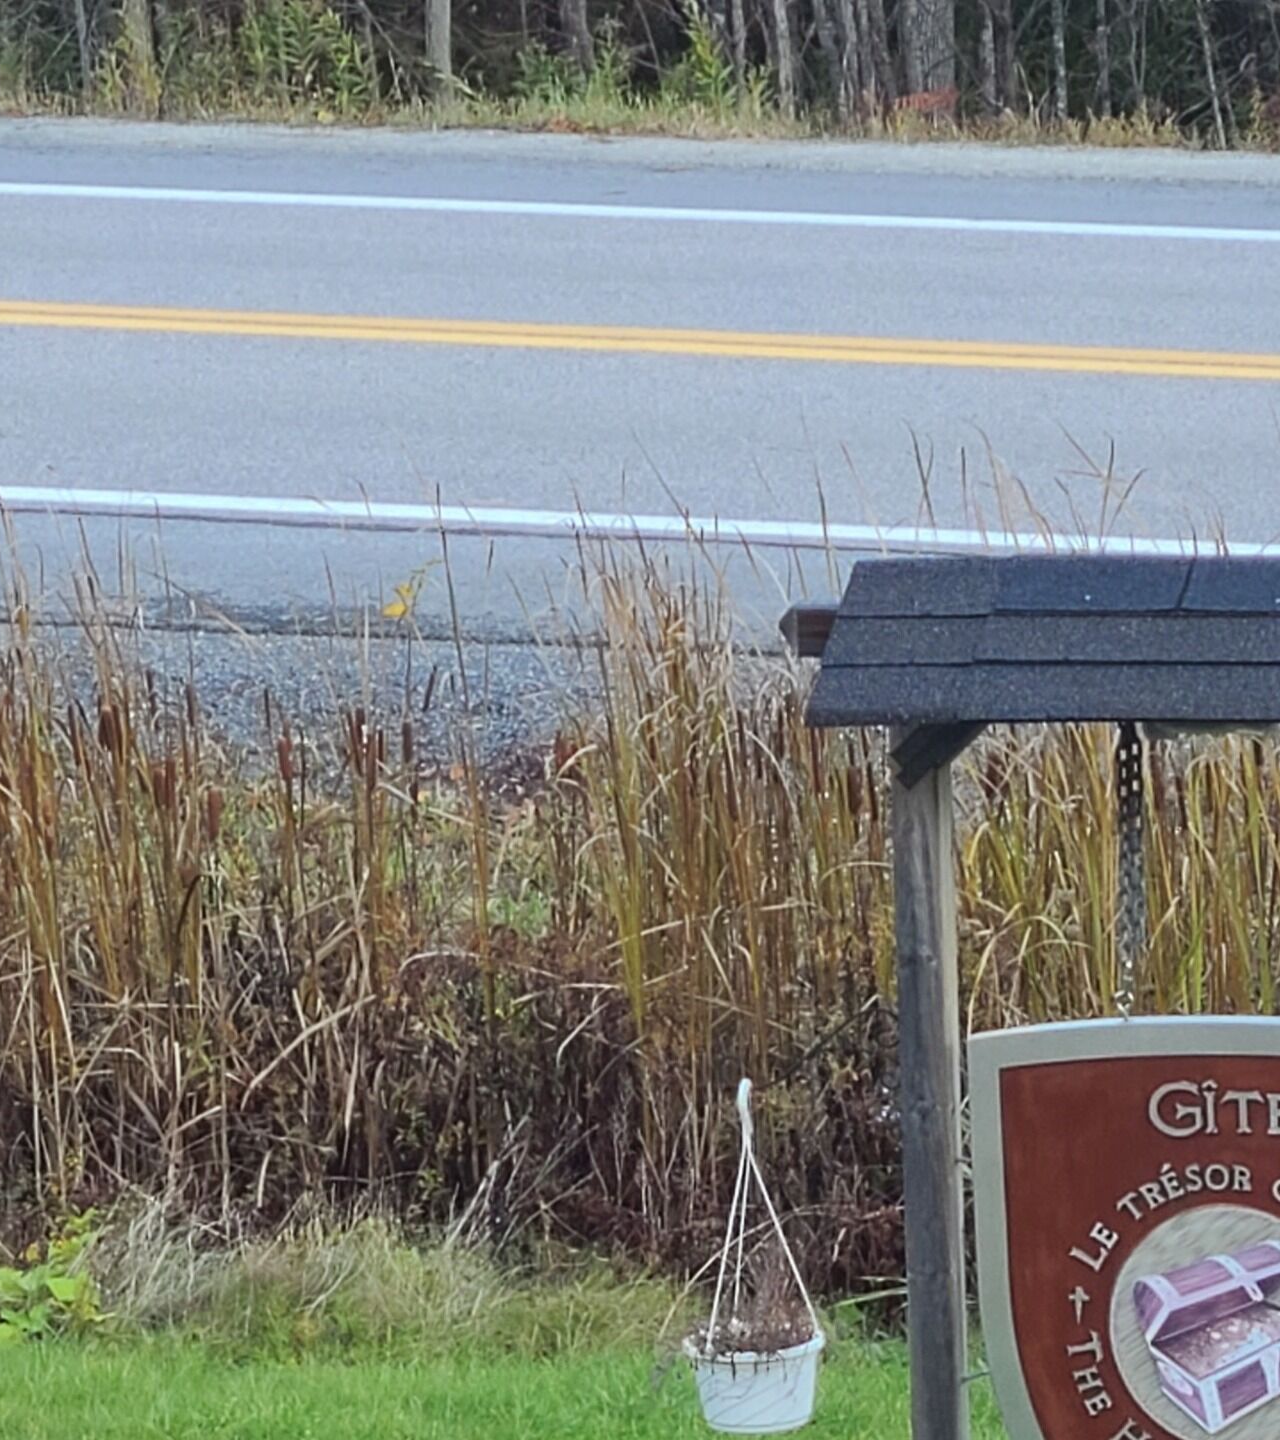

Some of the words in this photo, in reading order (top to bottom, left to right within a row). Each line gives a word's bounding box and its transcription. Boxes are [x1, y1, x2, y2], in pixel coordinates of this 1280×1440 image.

[1068, 1221, 1120, 1273] LE
[1116, 1162, 1253, 1222] TRÉSOR
[1066, 1329, 1113, 1417] THE
